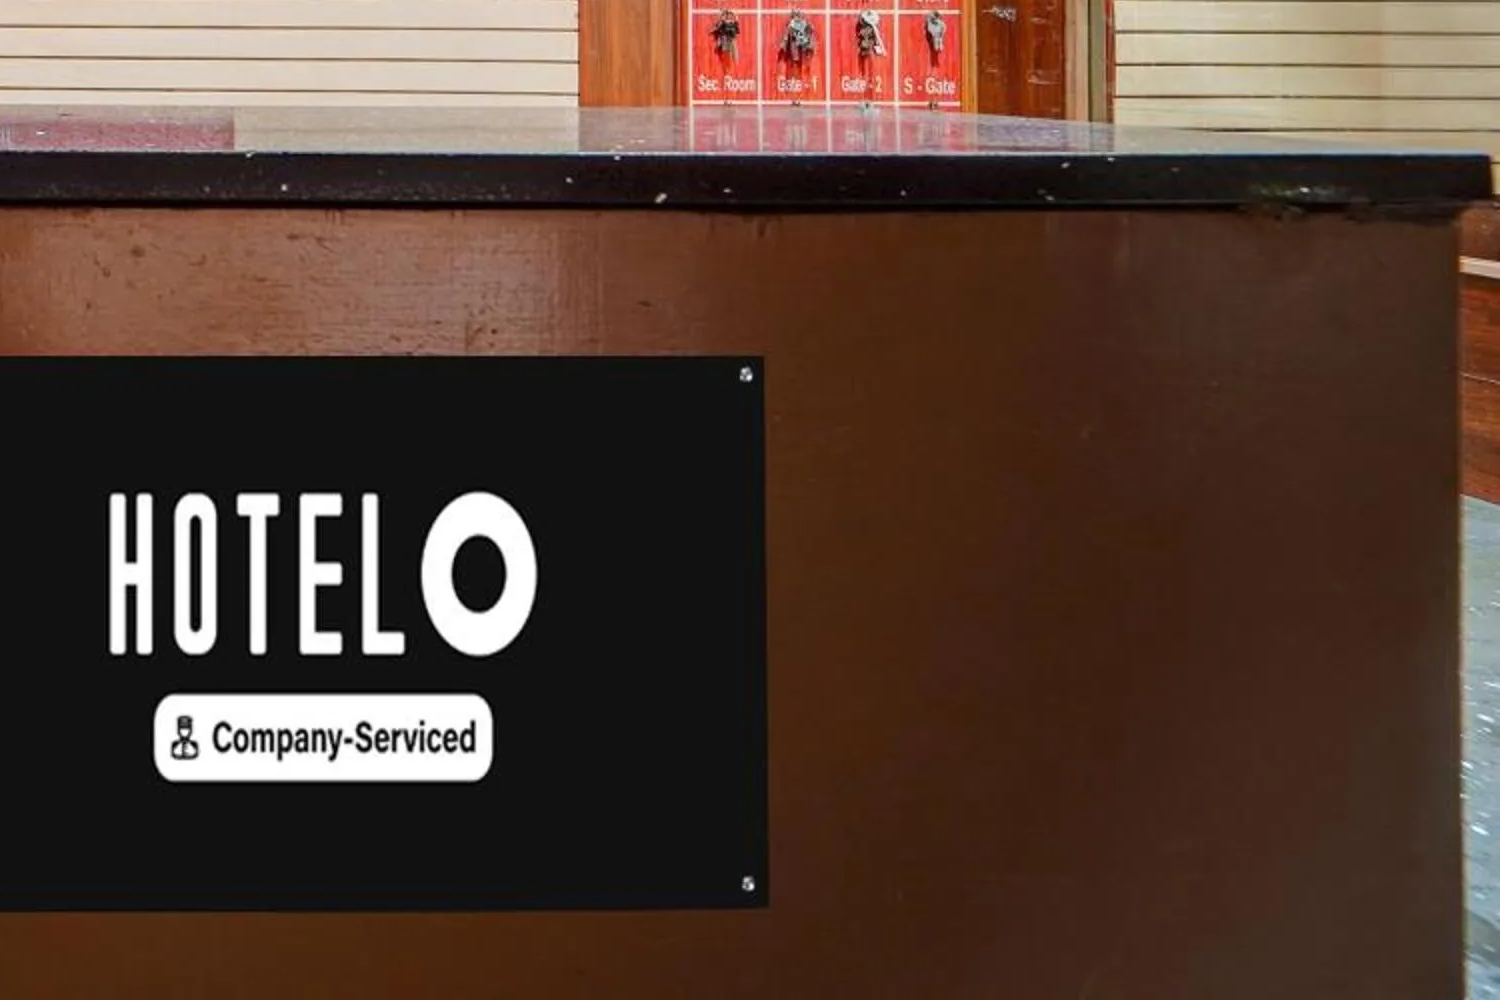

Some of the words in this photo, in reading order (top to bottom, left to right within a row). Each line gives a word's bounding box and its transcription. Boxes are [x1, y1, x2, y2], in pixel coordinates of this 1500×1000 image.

[724, 76, 756, 92] Room
[777, 76, 802, 92] Gate
[841, 76, 866, 92] Gate
[874, 77, 882, 92] 2
[903, 77, 913, 95] S
[925, 77, 955, 95] Gate
[109, 492, 405, 655] HOTEL
[420, 490, 538, 657] O
[212, 719, 477, 761] Company-Serviced
